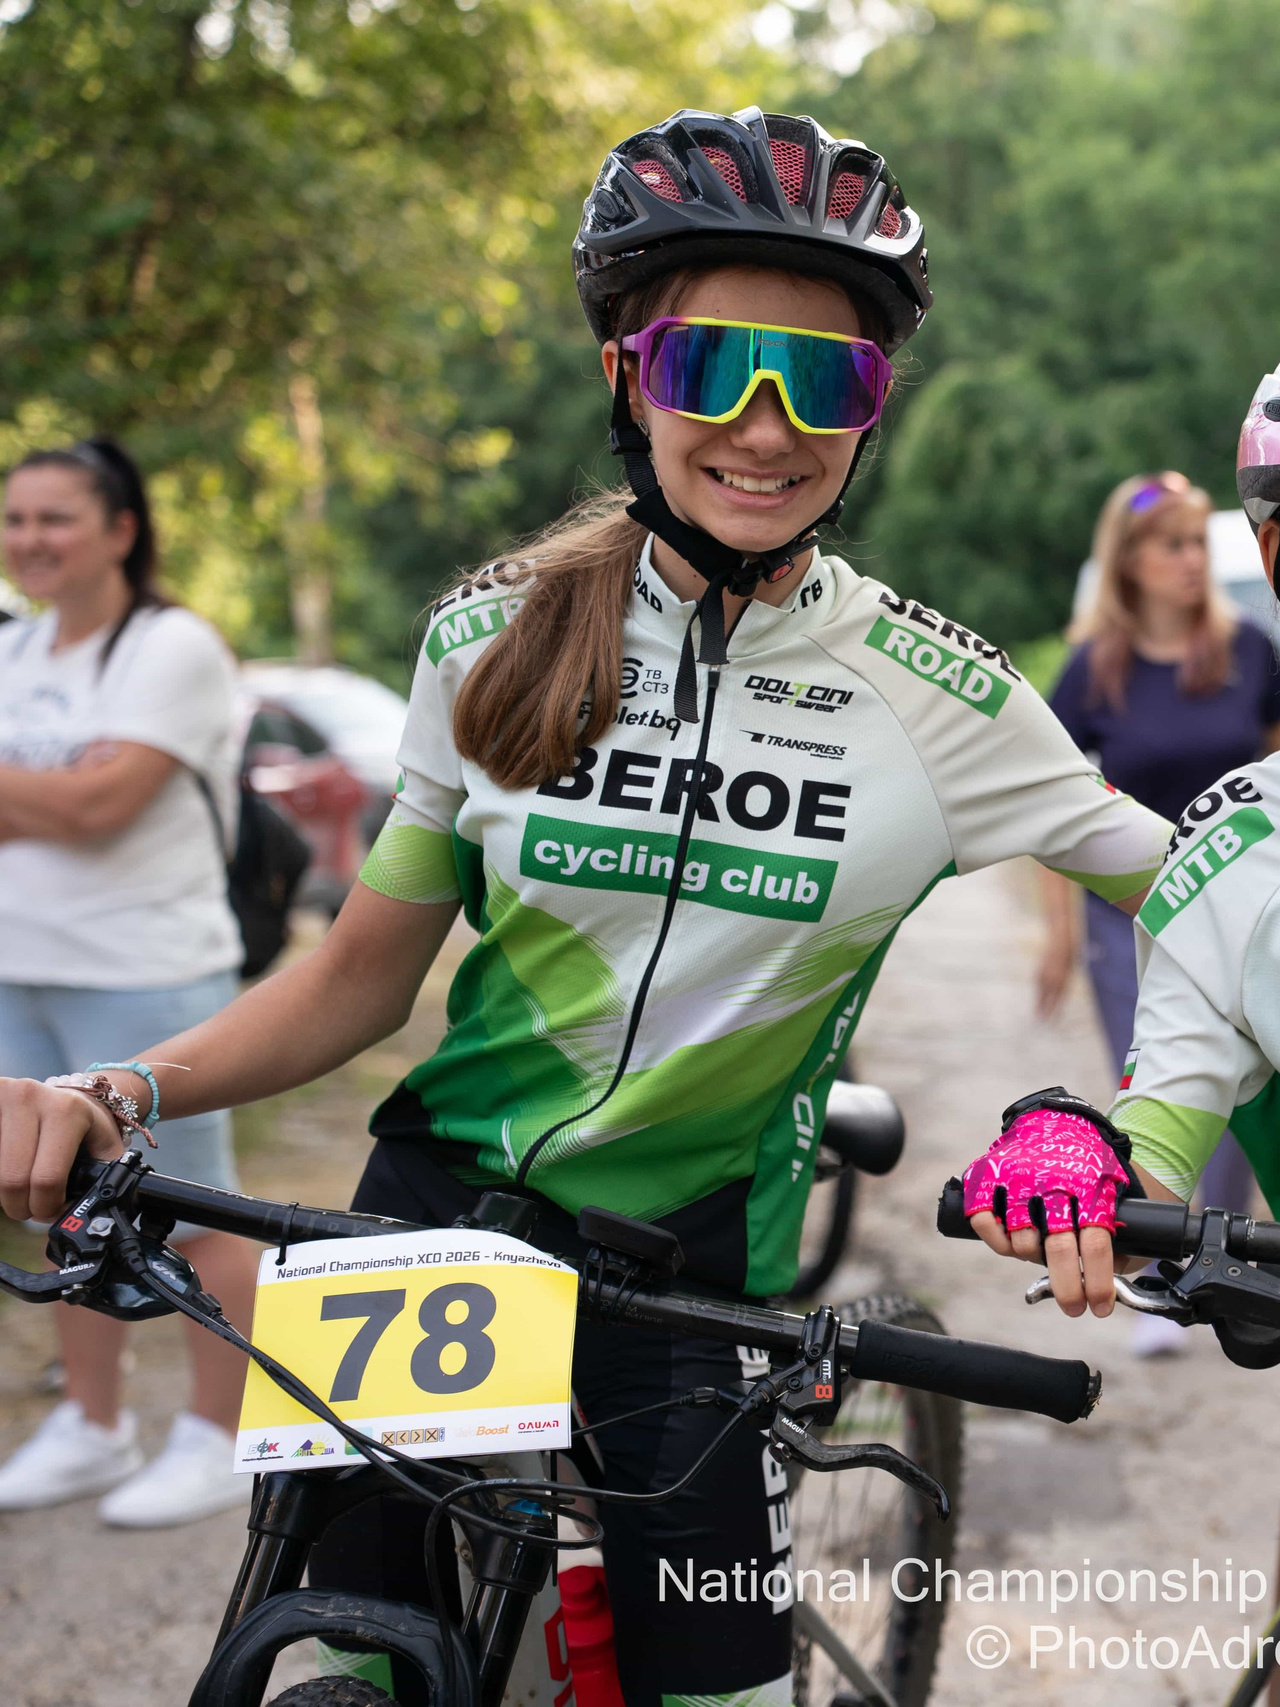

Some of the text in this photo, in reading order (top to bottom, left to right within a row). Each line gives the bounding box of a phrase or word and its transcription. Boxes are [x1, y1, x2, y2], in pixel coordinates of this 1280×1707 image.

[633, 567, 662, 614] OAD
[791, 578, 823, 614] TB
[882, 627, 993, 702] ROAD
[767, 735, 848, 756] TRANSPRESS
[536, 746, 852, 842] BEROE
[534, 839, 820, 904] cycling club
[1158, 826, 1243, 910] MTB
[61, 1216, 84, 1233] 8
[59, 1262, 95, 1275] MAGURA
[277, 1263, 326, 1279] National
[329, 1255, 413, 1273] Championship
[417, 1253, 441, 1265] XCO
[445, 1251, 480, 1263] 2026
[493, 1251, 562, 1269] Knyazhevo
[320, 1282, 496, 1403] 78
[815, 1384, 833, 1399] 8
